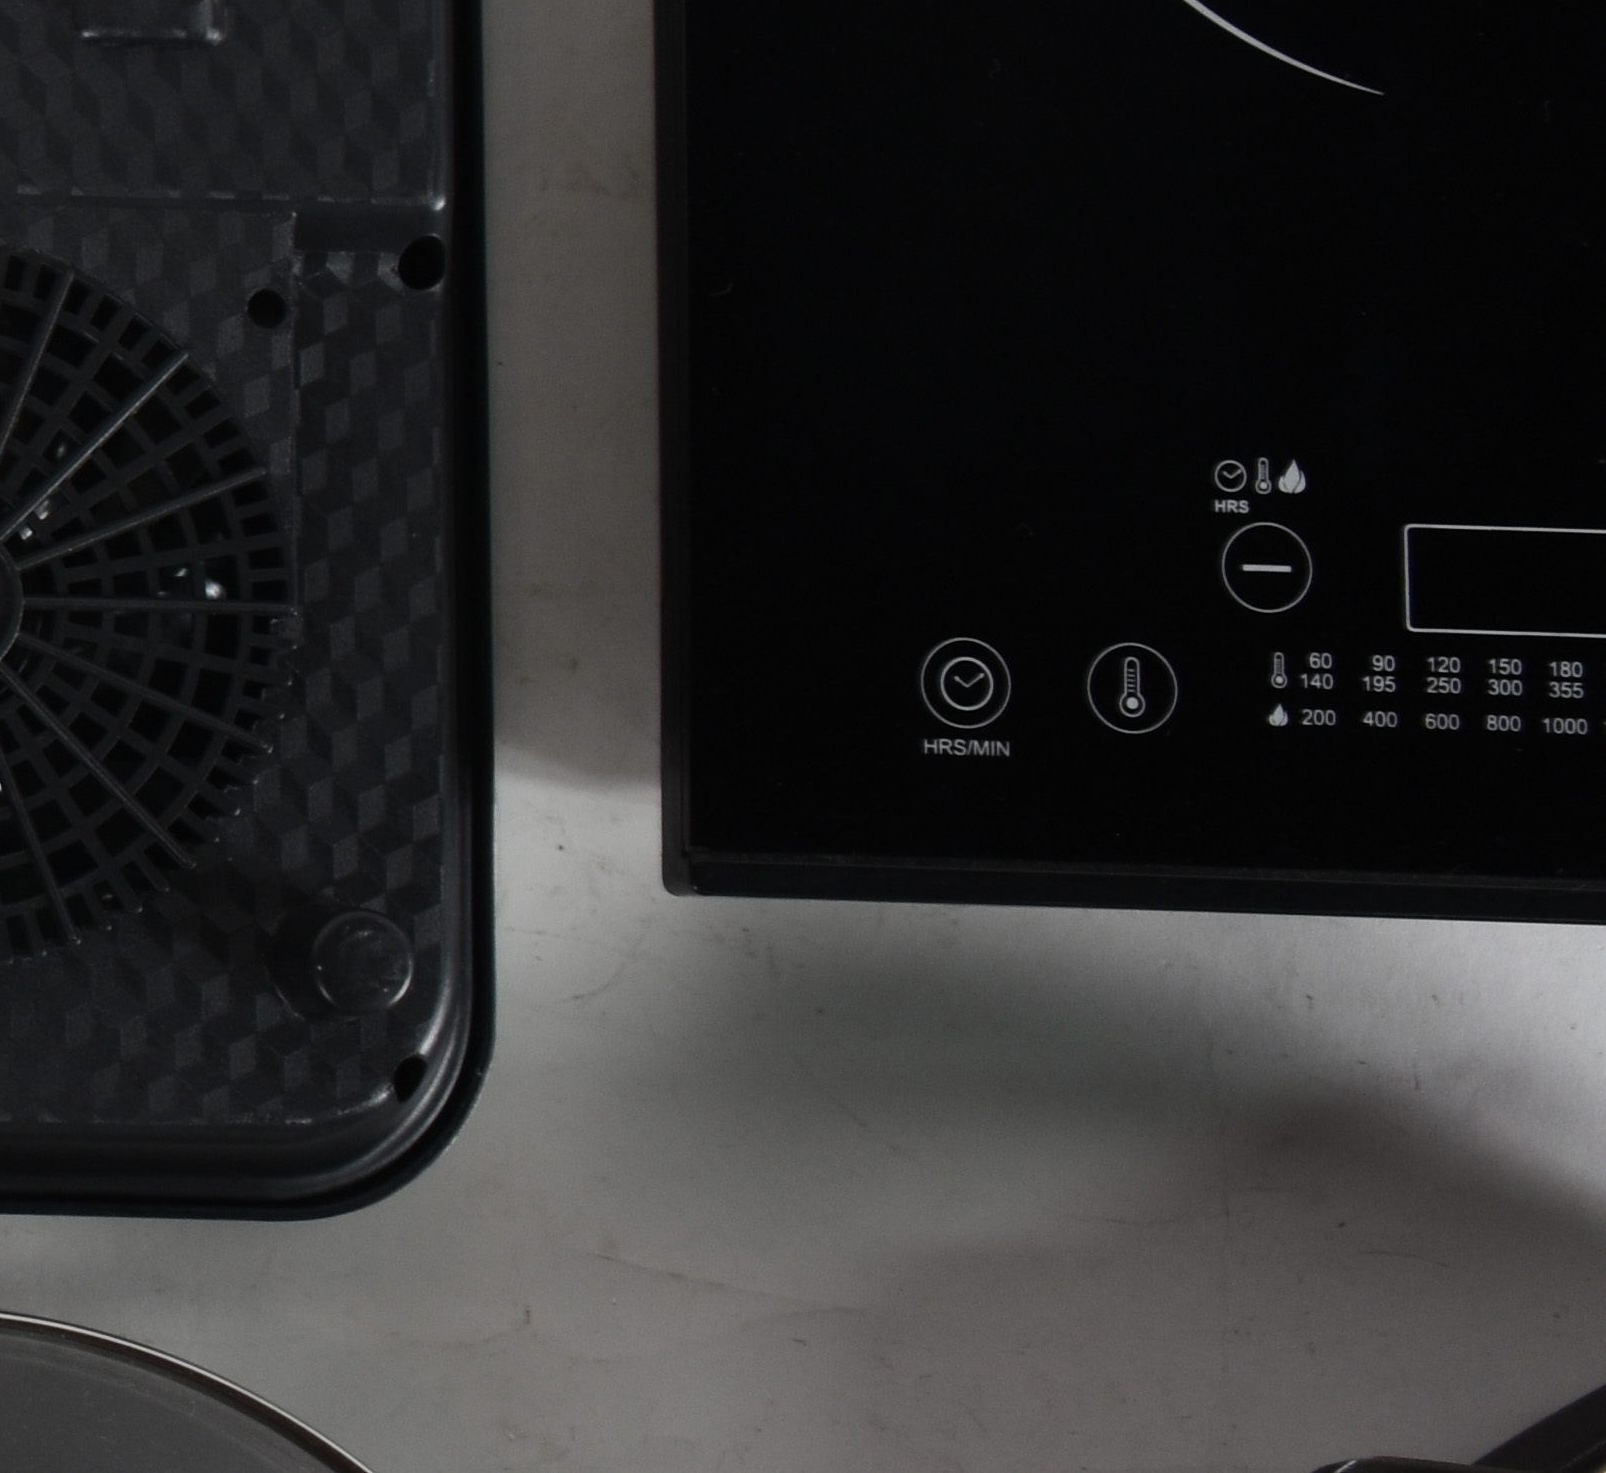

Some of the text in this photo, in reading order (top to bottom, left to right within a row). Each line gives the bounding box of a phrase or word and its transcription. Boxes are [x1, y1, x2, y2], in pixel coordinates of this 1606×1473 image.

[1214, 499, 1250, 514] HRS
[1309, 652, 1584, 678] 60 90 120 150 180
[1300, 673, 1584, 699] 140 195 250 300 355
[1301, 709, 1588, 735] 200 400 600 800 1000
[922, 737, 1011, 757] HRS/MIN
